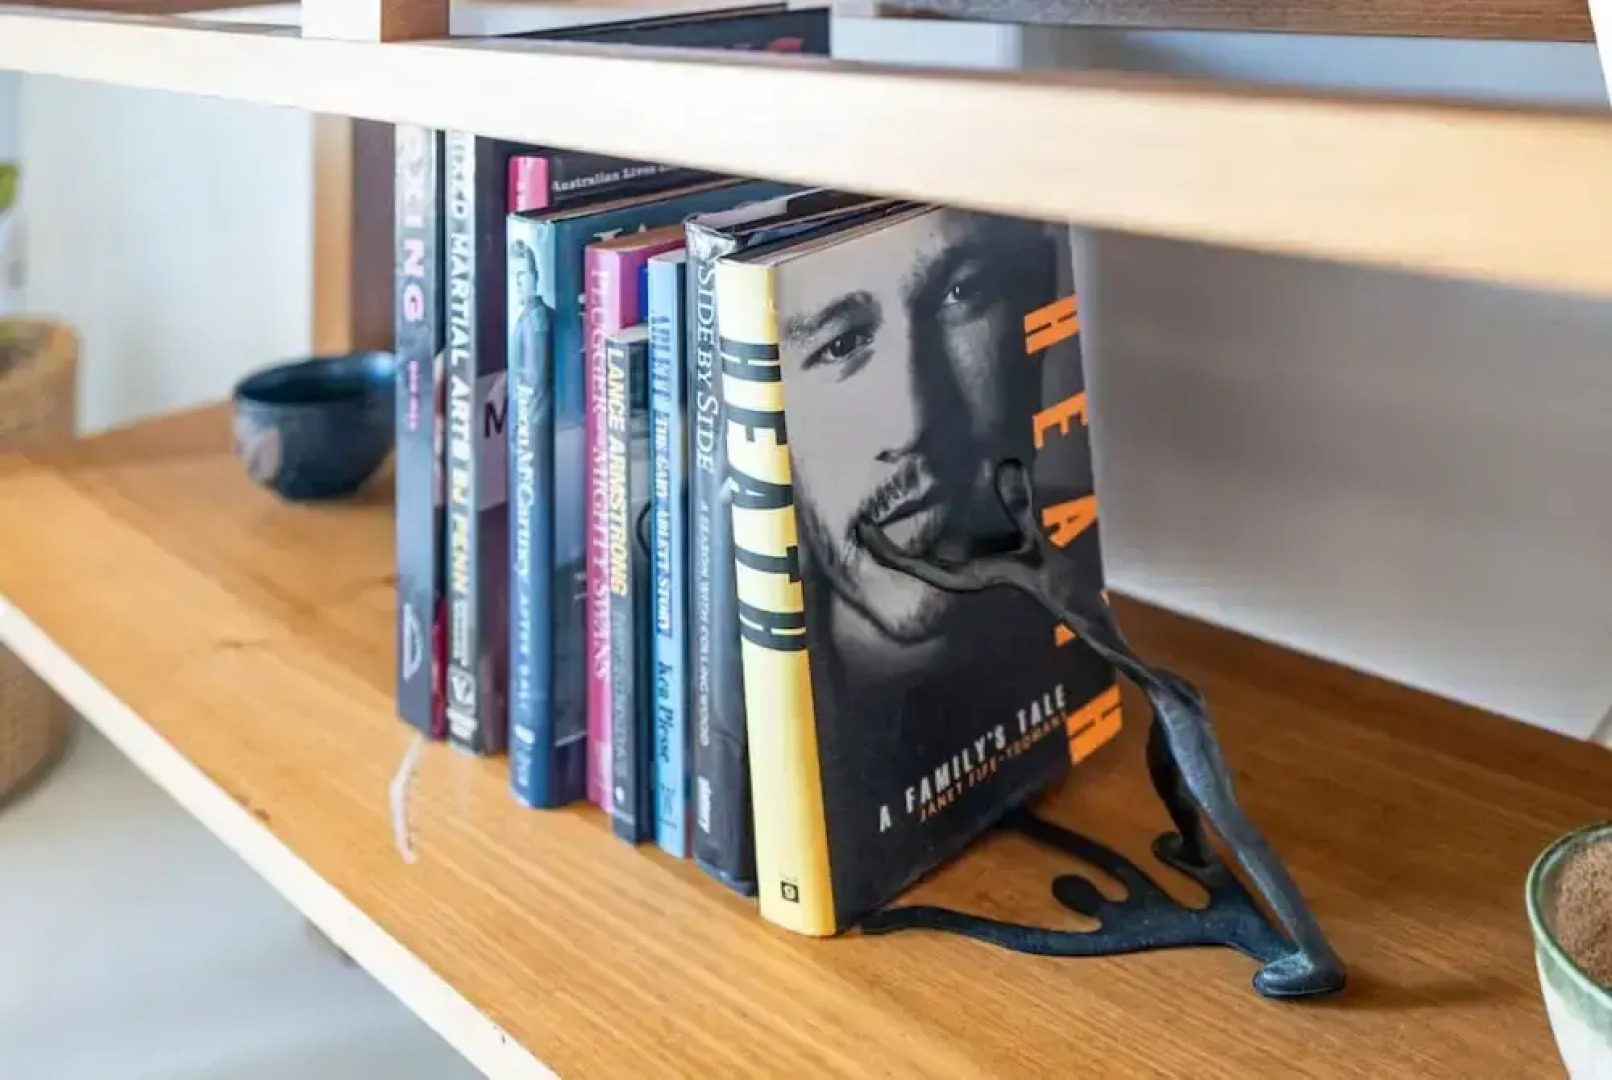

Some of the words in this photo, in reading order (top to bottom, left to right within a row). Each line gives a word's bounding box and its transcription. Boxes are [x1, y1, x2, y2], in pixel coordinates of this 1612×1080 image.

[402, 125, 425, 322] OXING
[552, 171, 620, 192] Australian
[450, 233, 470, 367] MARTIAL
[591, 267, 611, 414] PLUGGER
[697, 264, 717, 345] SIDE
[697, 346, 713, 387] BY
[607, 348, 627, 433] LANCE
[696, 390, 719, 475] SIDE
[607, 436, 628, 598] ARMSTRONG
[717, 337, 808, 653] HEATH
[879, 804, 893, 833] A
[904, 723, 1007, 815] FAMILY'S
[1016, 683, 1066, 735] TALE
